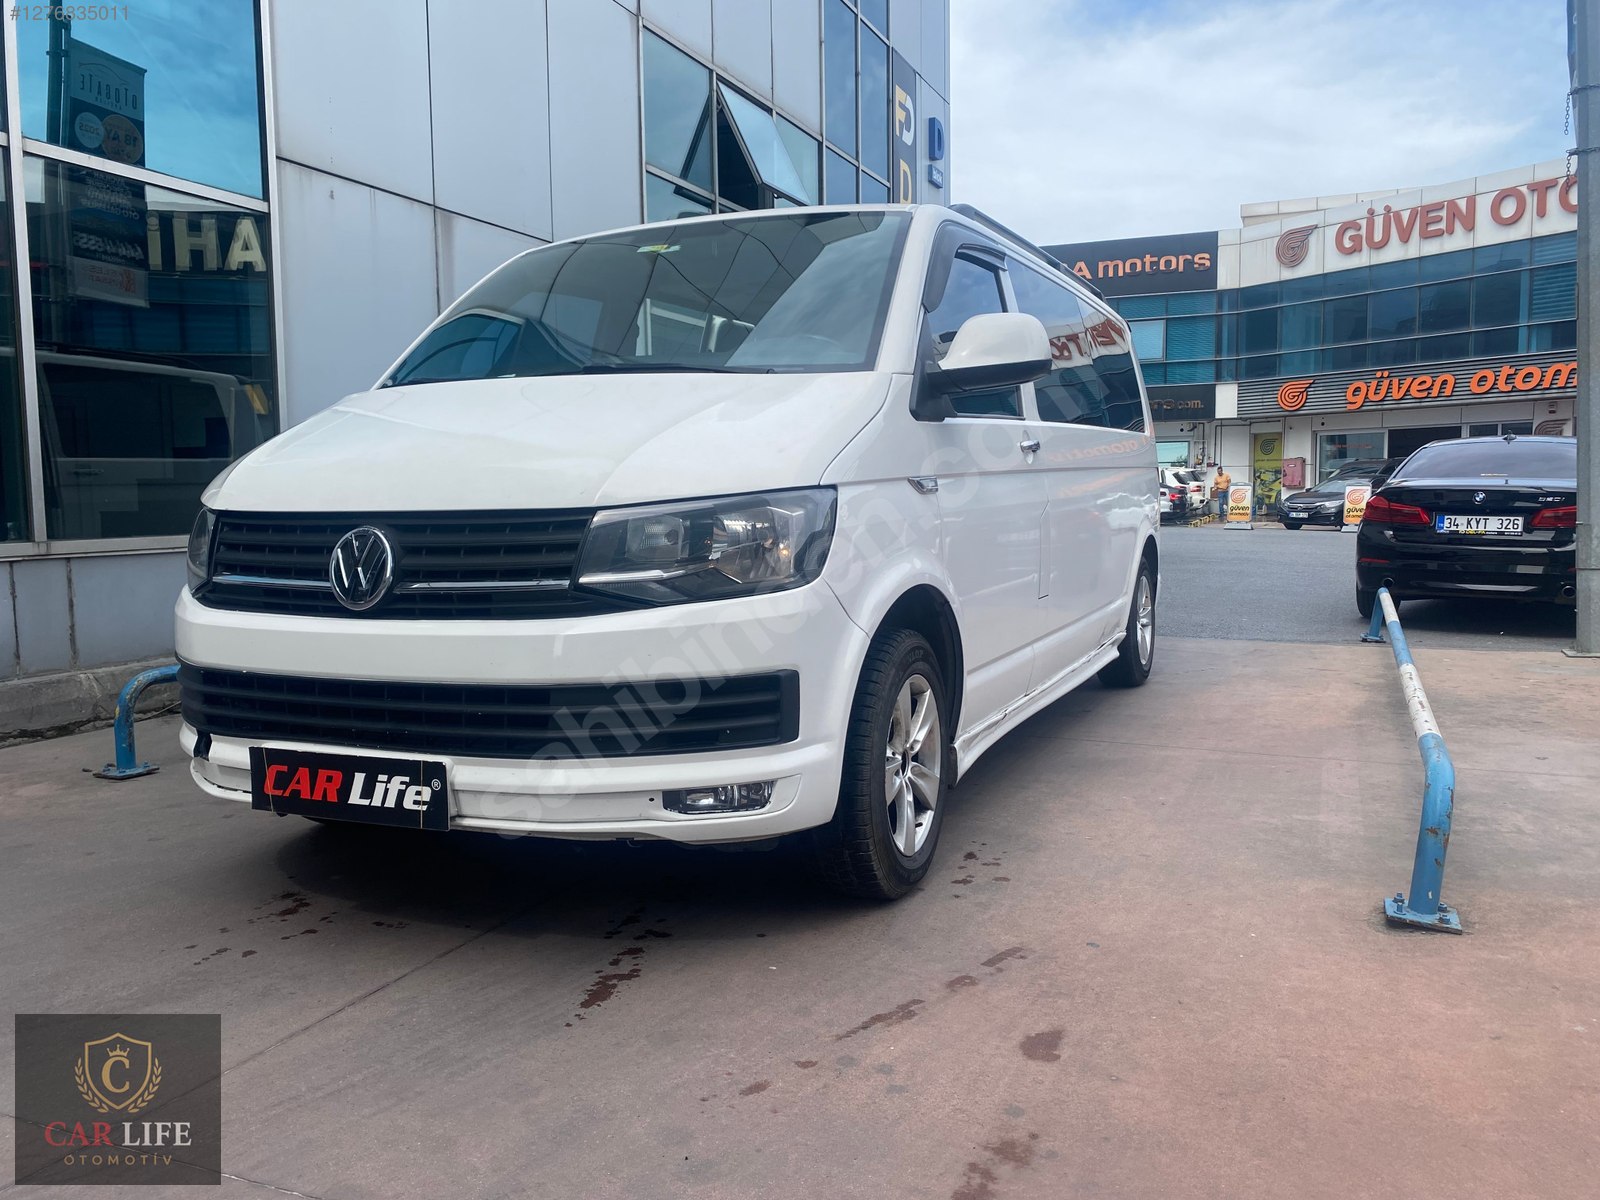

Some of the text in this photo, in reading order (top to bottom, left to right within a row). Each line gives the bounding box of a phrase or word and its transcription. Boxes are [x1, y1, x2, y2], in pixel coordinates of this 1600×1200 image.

[929, 117, 945, 161] D
[1335, 195, 1476, 255] GÜVEN
[1066, 252, 1211, 280] A motors
[1346, 370, 1456, 410] güven
[1445, 517, 1520, 530] 34 KYT 326
[264, 764, 343, 803] CAR
